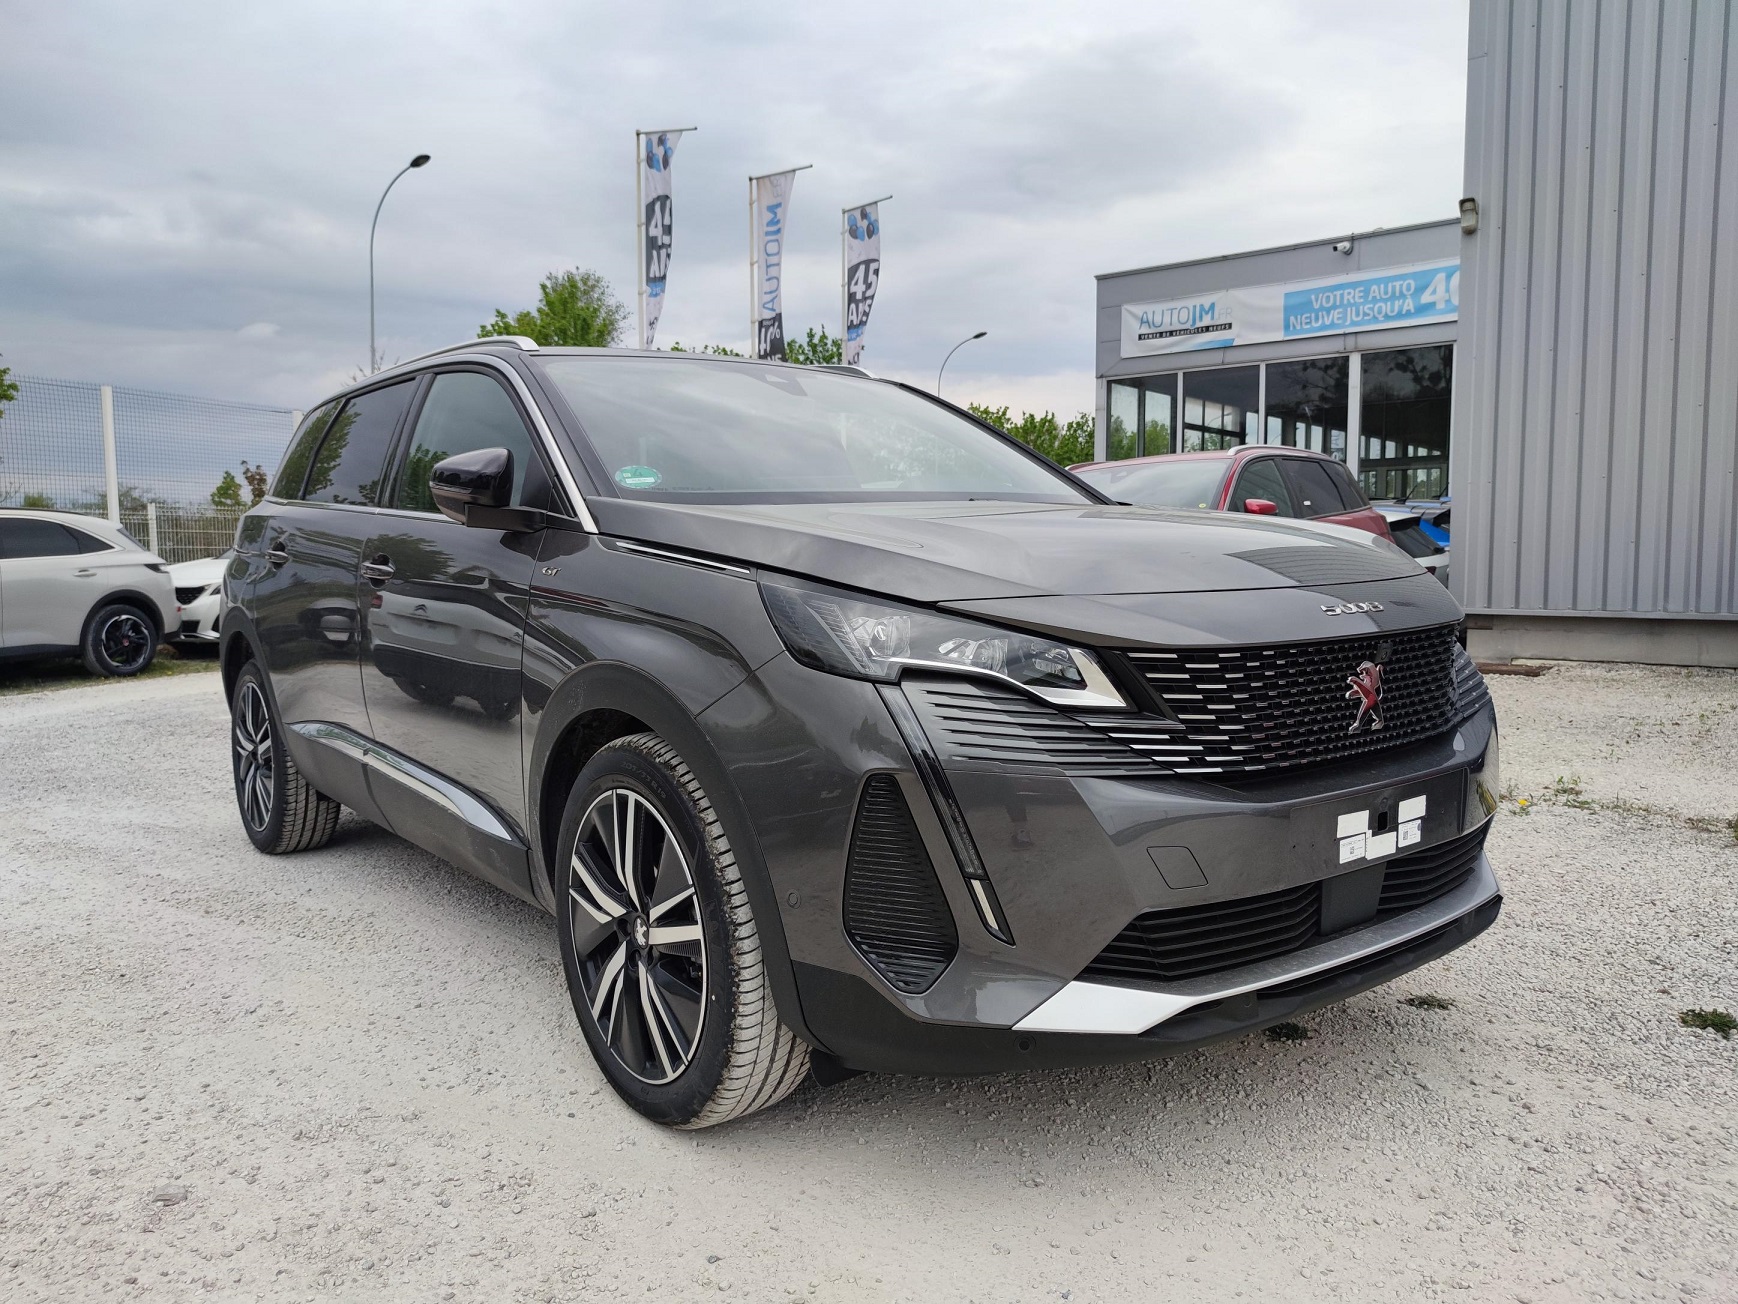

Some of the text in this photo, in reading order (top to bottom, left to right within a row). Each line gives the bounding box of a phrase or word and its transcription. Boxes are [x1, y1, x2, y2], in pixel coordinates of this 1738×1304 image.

[850, 262, 879, 300] 45
[1311, 279, 1415, 309] VOTRE AUTO
[1289, 296, 1415, 331] NEUVE JUSQU'À
[541, 566, 562, 577] GT
[1321, 602, 1384, 616] 5008
